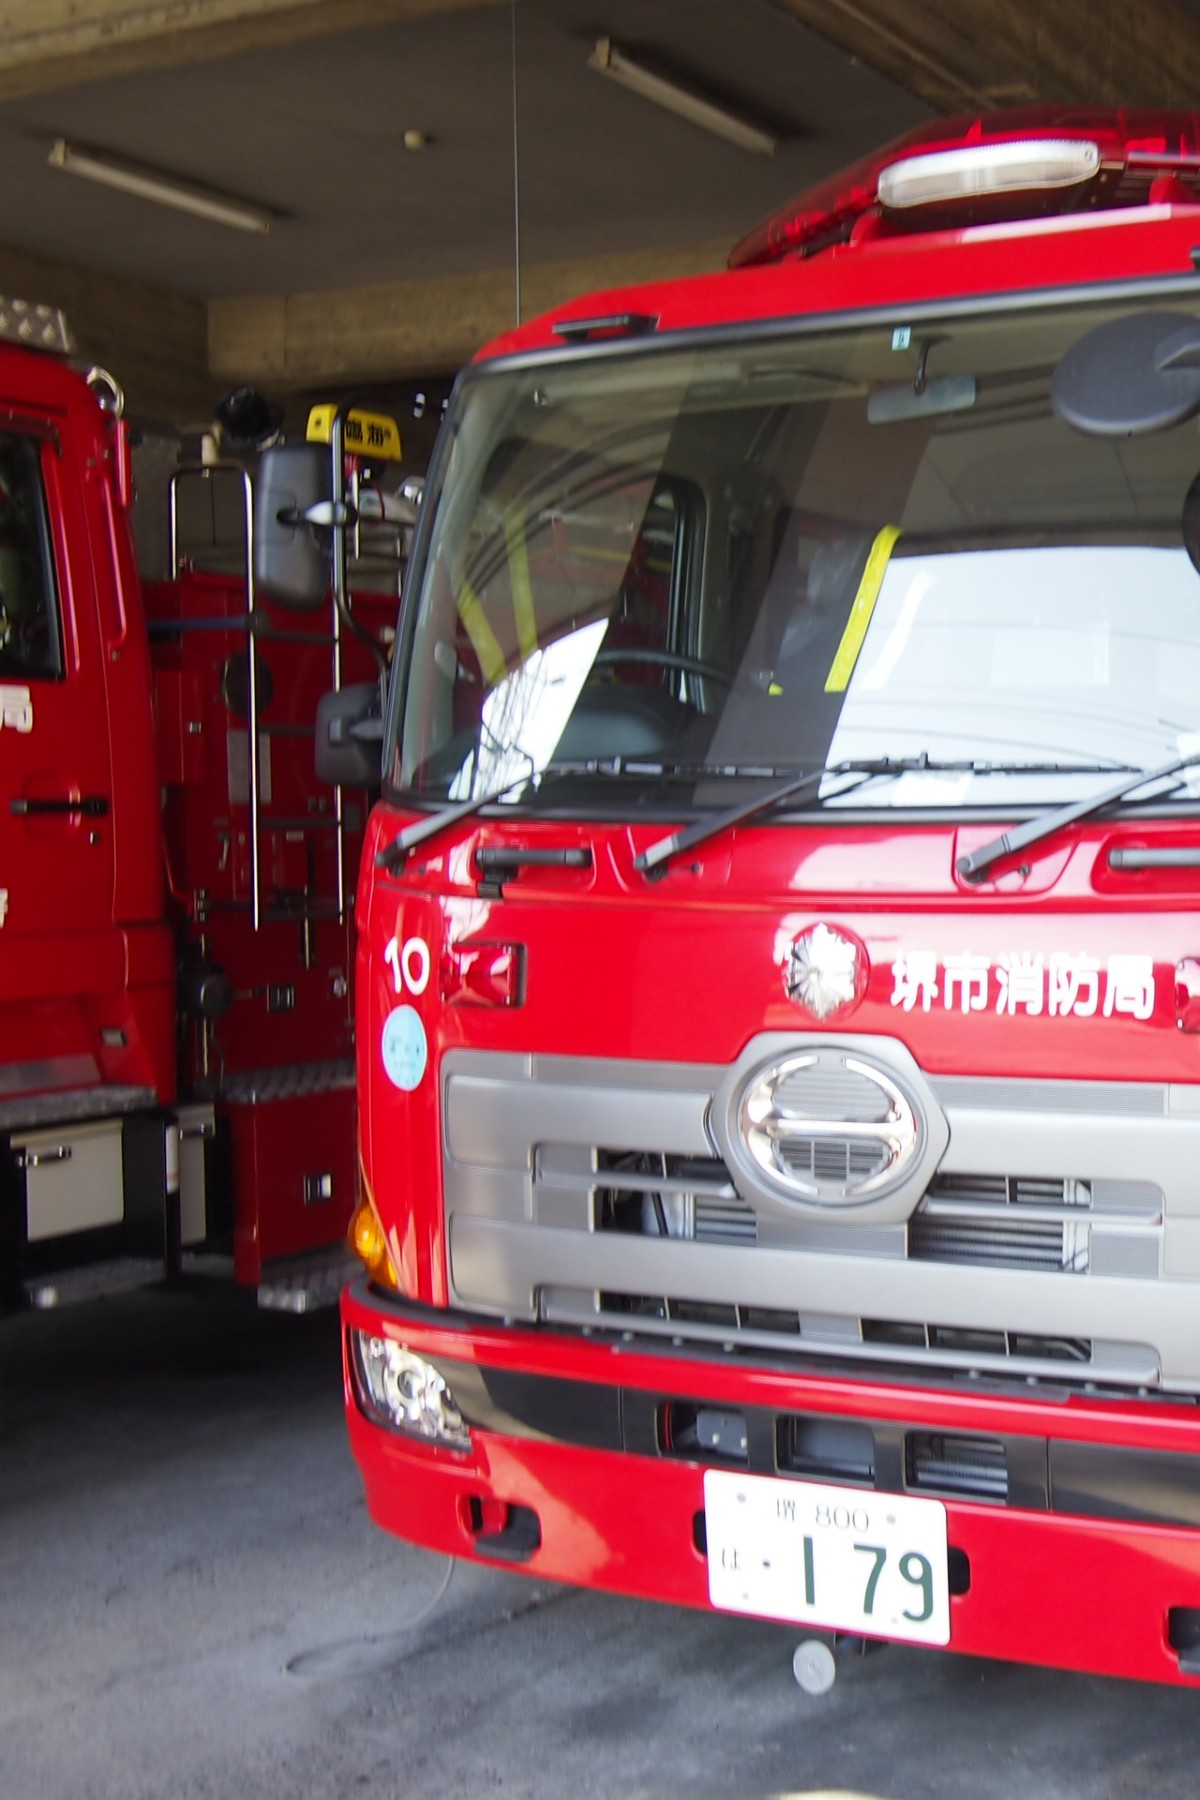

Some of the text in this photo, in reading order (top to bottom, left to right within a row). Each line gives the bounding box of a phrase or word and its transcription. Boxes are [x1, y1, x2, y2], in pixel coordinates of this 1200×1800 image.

[384, 935, 431, 996] 10
[889, 949, 1156, 1021] 堺市消防局
[815, 1503, 870, 1533] 800
